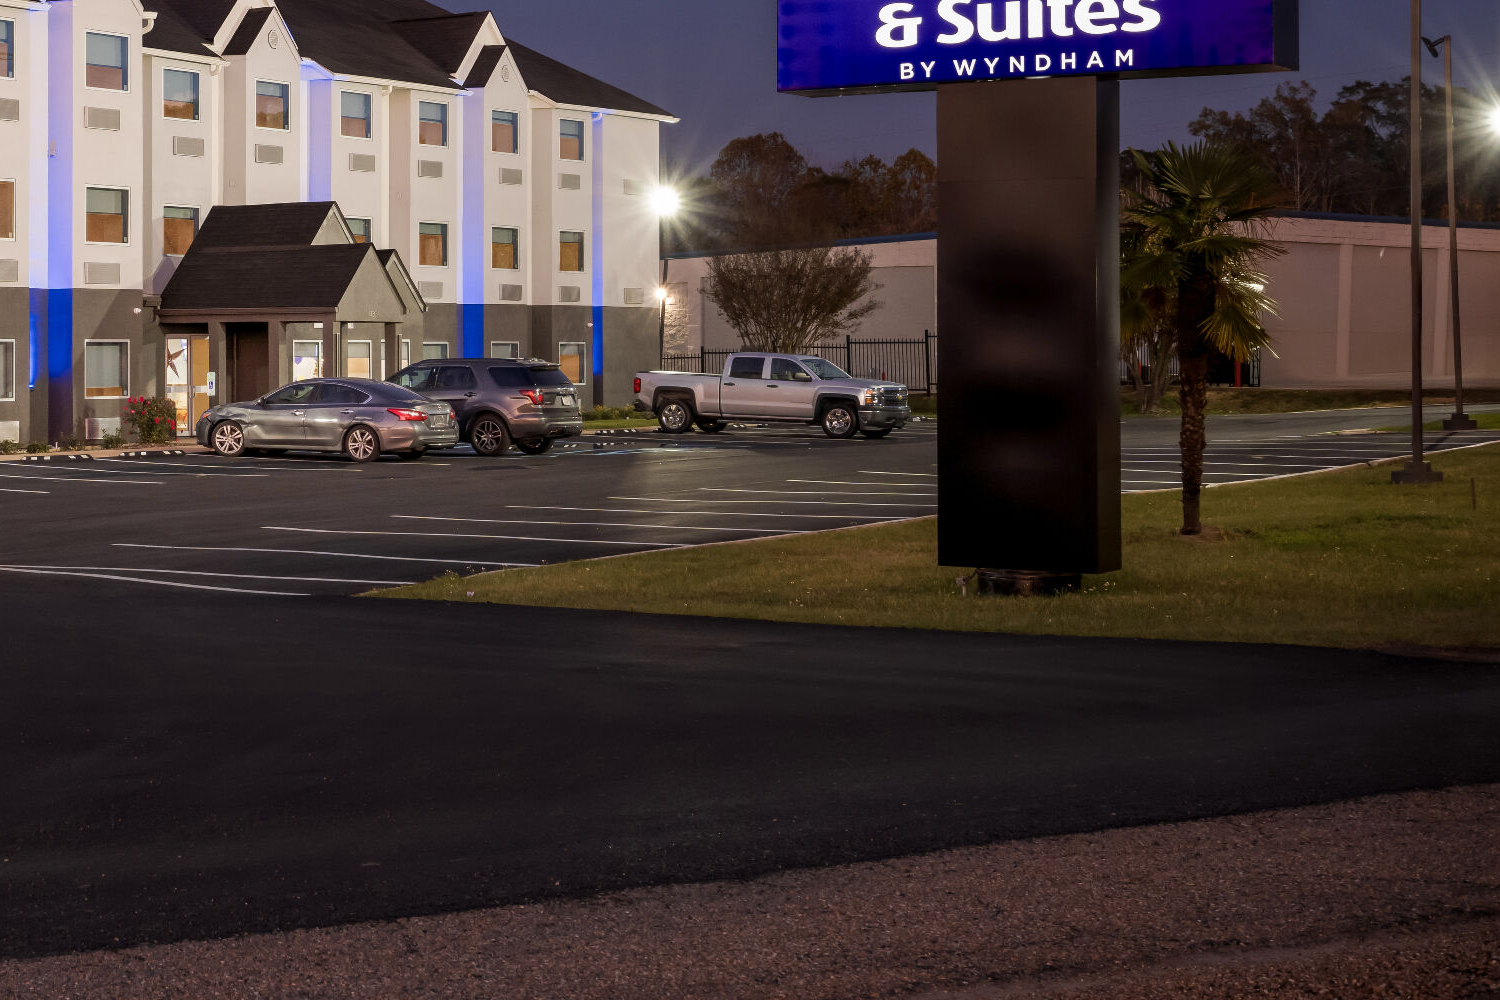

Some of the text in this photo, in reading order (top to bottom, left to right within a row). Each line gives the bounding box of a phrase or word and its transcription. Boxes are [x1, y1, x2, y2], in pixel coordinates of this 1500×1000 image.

[875, 2, 923, 48] &
[899, 48, 1135, 81] BY WYNDHAM
